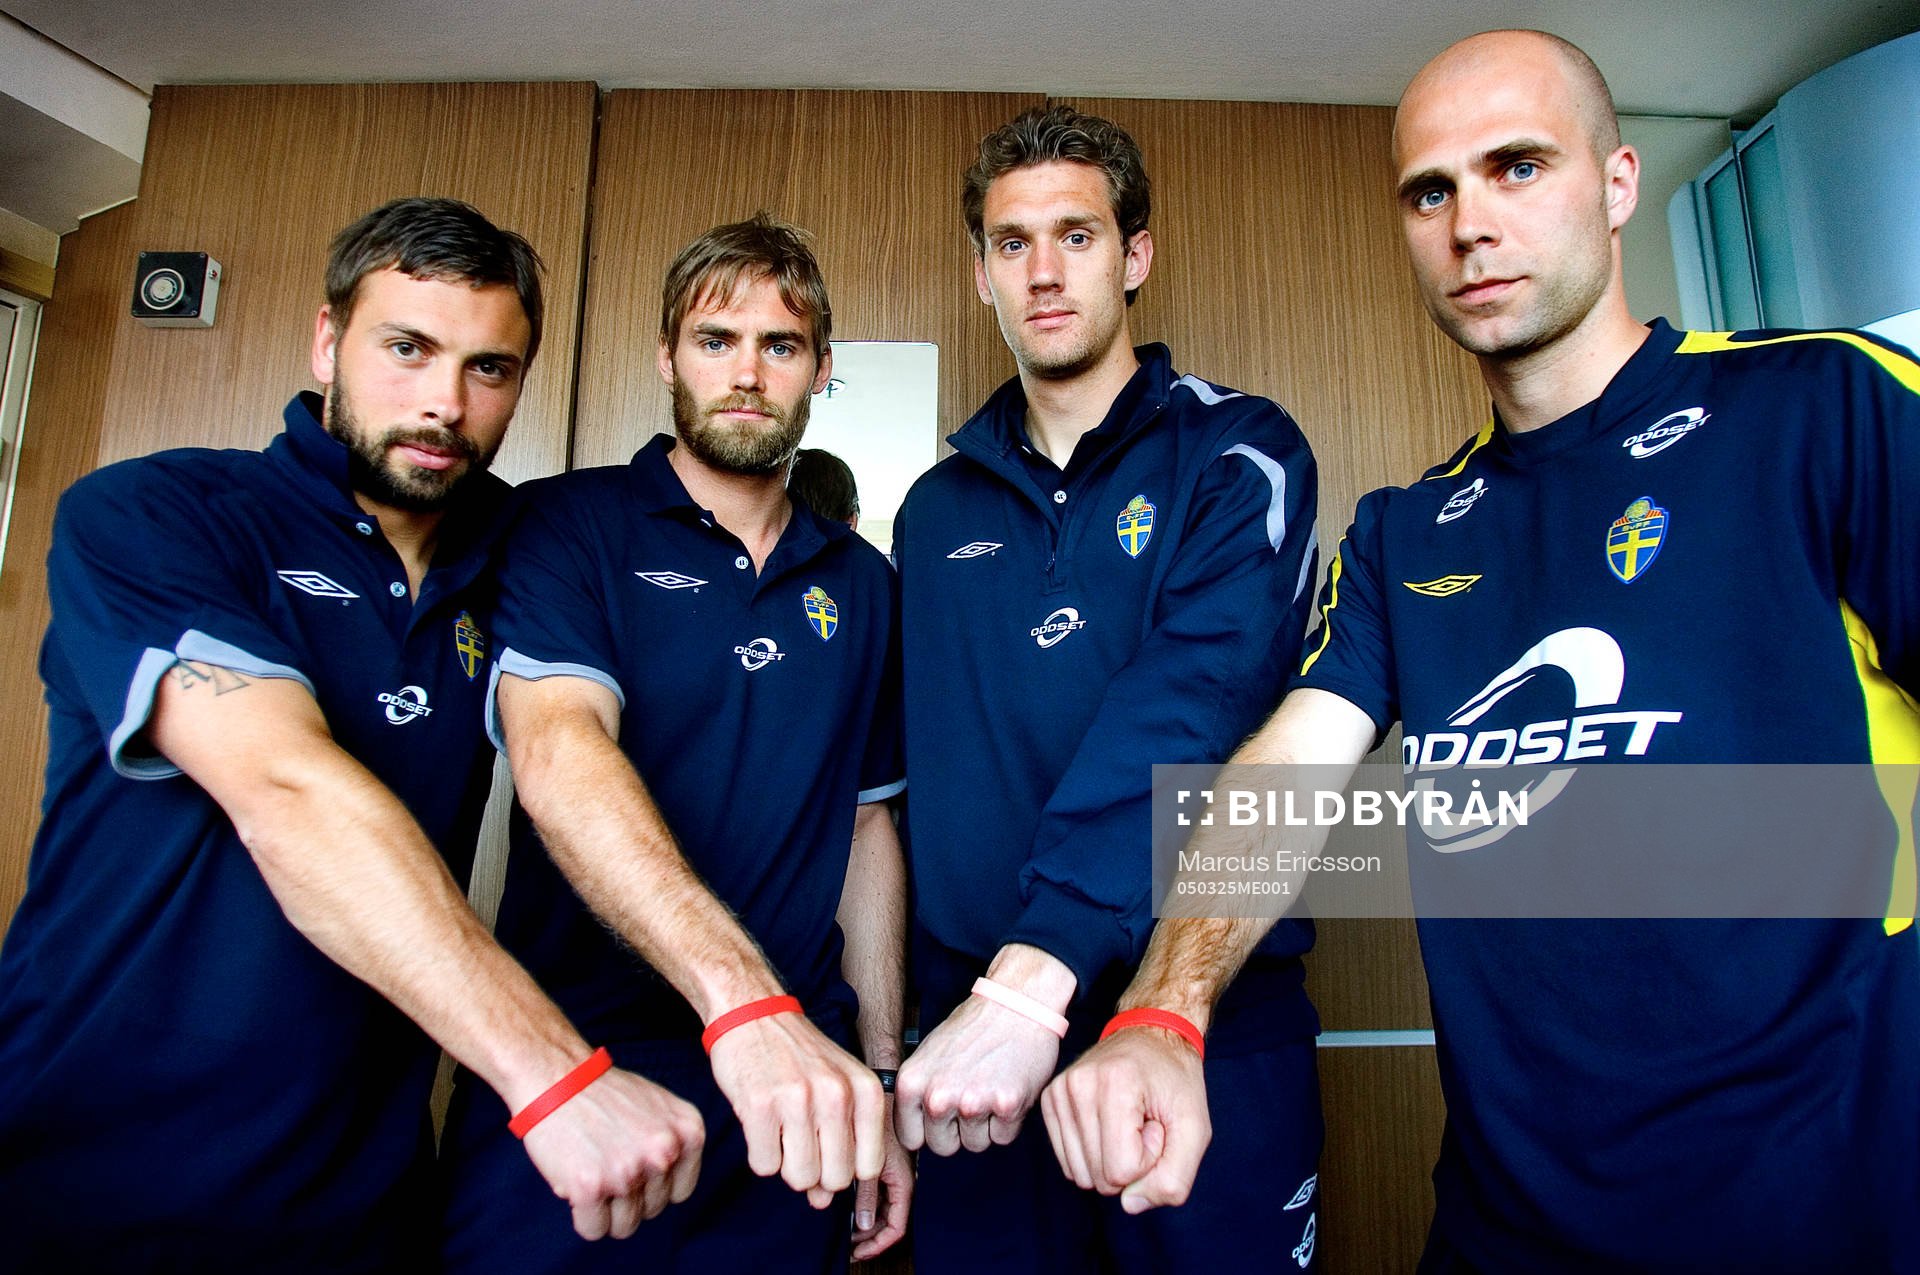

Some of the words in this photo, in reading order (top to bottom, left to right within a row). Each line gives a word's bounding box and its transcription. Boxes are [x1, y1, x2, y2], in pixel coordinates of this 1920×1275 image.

[1622, 413, 1712, 448] ODDSET
[1030, 620, 1087, 637] ODDSET
[734, 646, 786, 661] ODDSET
[378, 693, 433, 717] ODDSET
[1402, 711, 1684, 775] ODDSET
